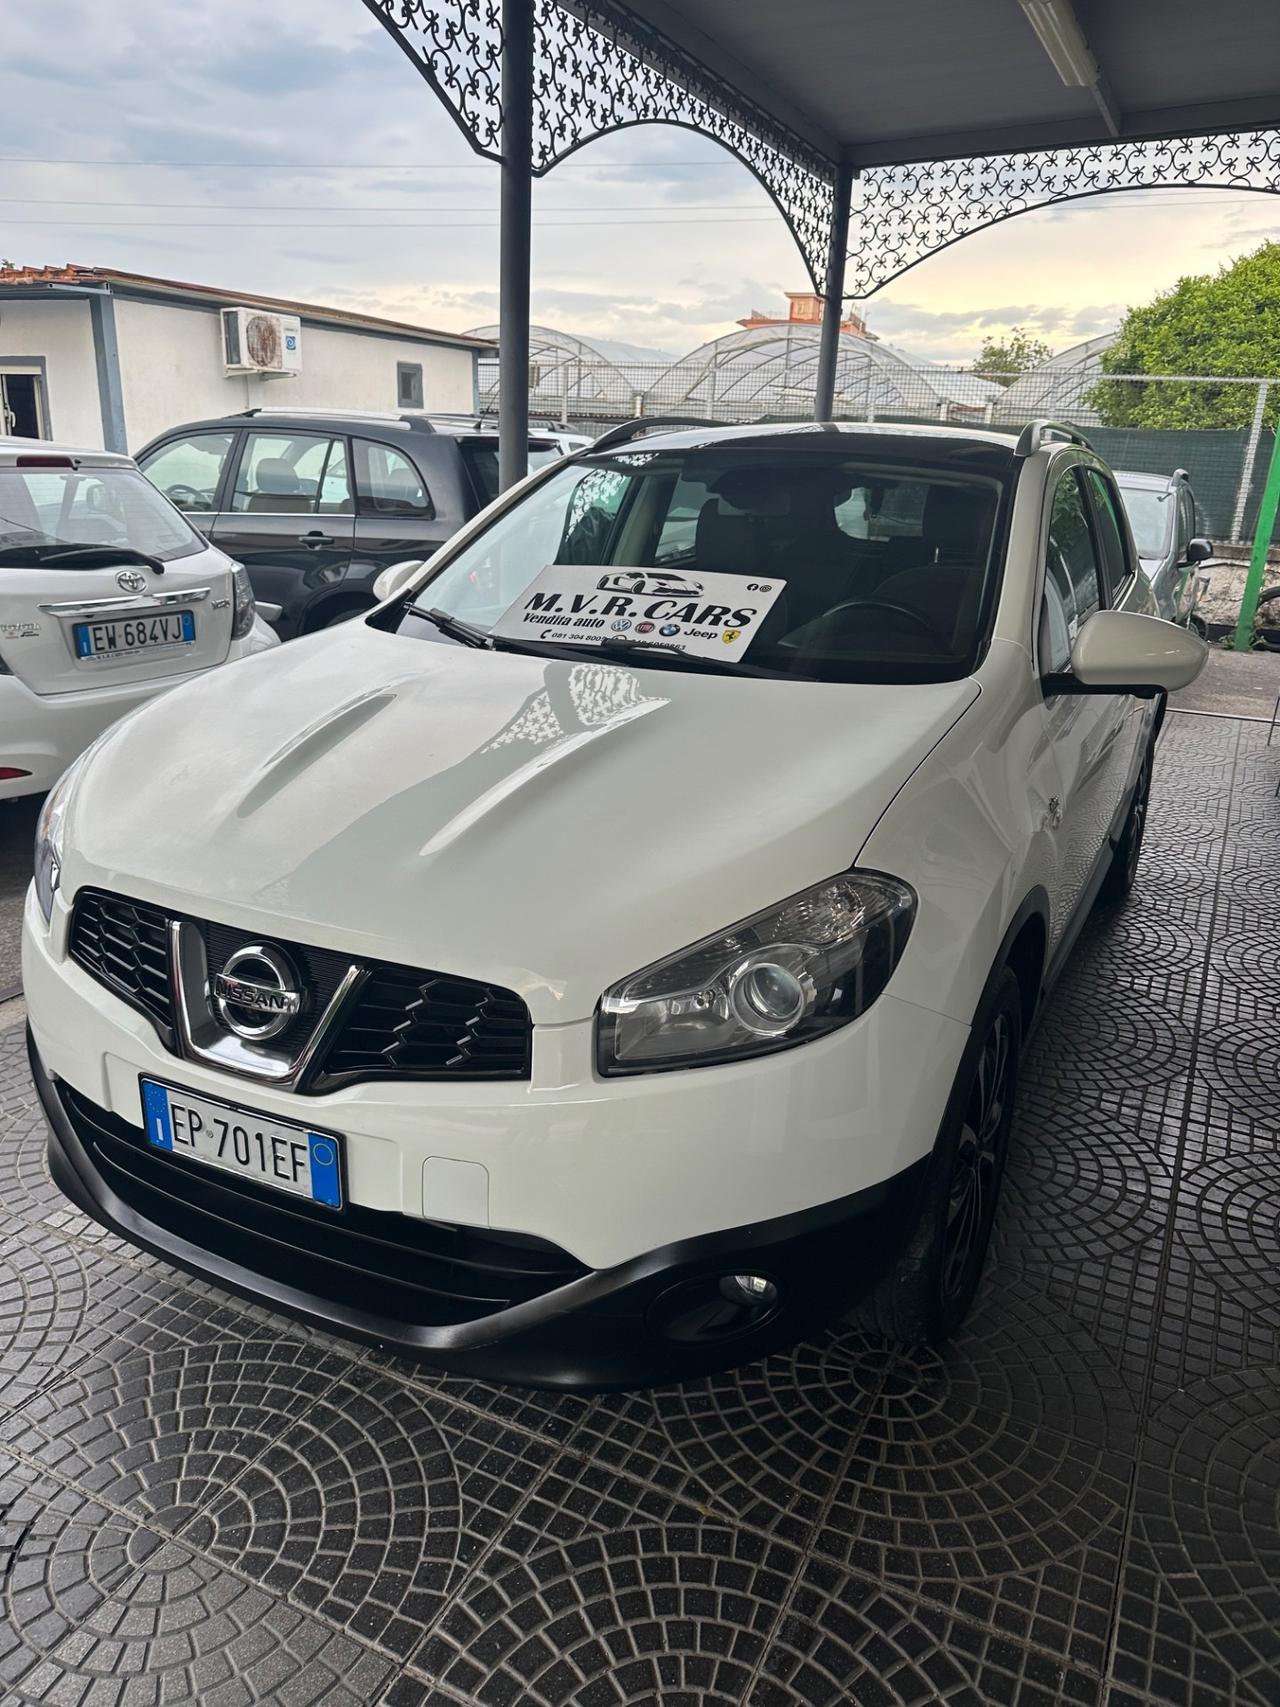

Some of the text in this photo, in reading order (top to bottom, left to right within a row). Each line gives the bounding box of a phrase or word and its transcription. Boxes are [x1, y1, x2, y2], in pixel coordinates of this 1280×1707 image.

[523, 612, 605, 629] Vendita auto
[524, 592, 758, 628] M.V.R. CARS
[92, 621, 118, 652] EW
[124, 613, 182, 646] 684VJ
[684, 628, 718, 640] Jeep
[215, 979, 286, 1009] NISSAN
[170, 1102, 203, 1147] EP
[213, 1118, 308, 1183] 701EF
